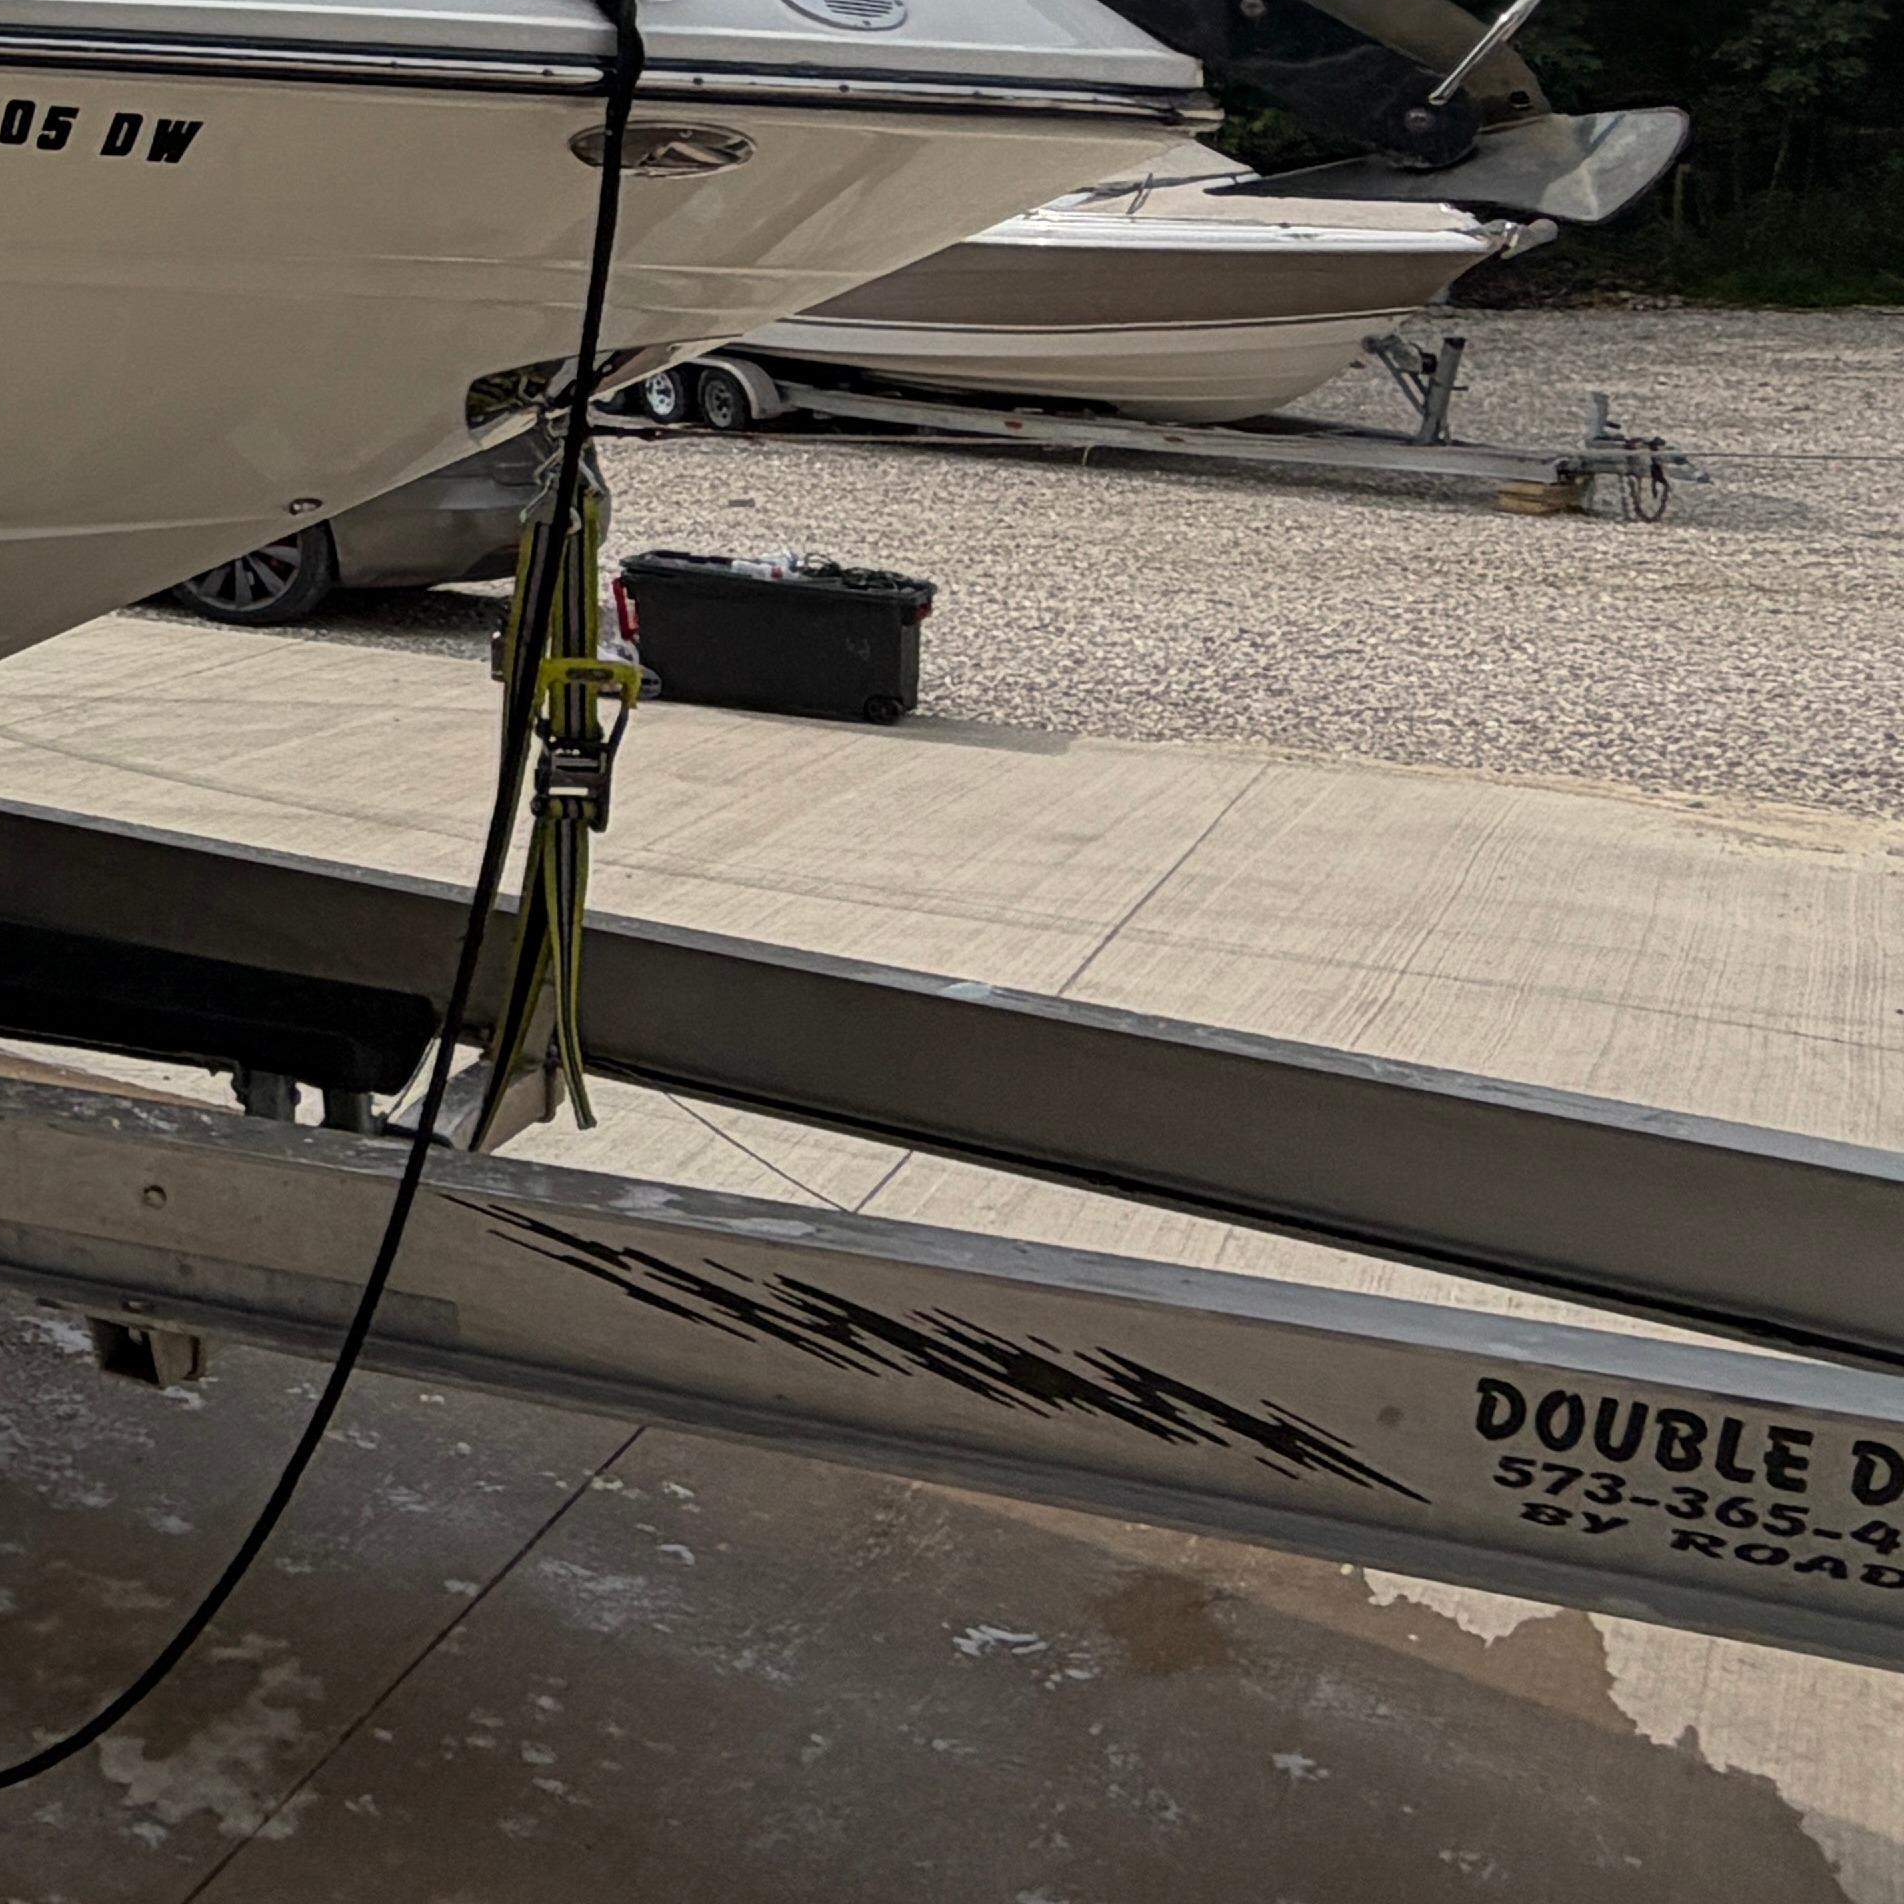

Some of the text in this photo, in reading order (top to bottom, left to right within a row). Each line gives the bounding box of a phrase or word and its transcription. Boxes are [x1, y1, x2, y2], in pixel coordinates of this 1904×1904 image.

[100, 113, 202, 163] DW
[1476, 1377, 1814, 1493] DOUBLE
[1493, 1456, 1901, 1555] 573-365-4
[1520, 1502, 1904, 1589] BY ROAD
